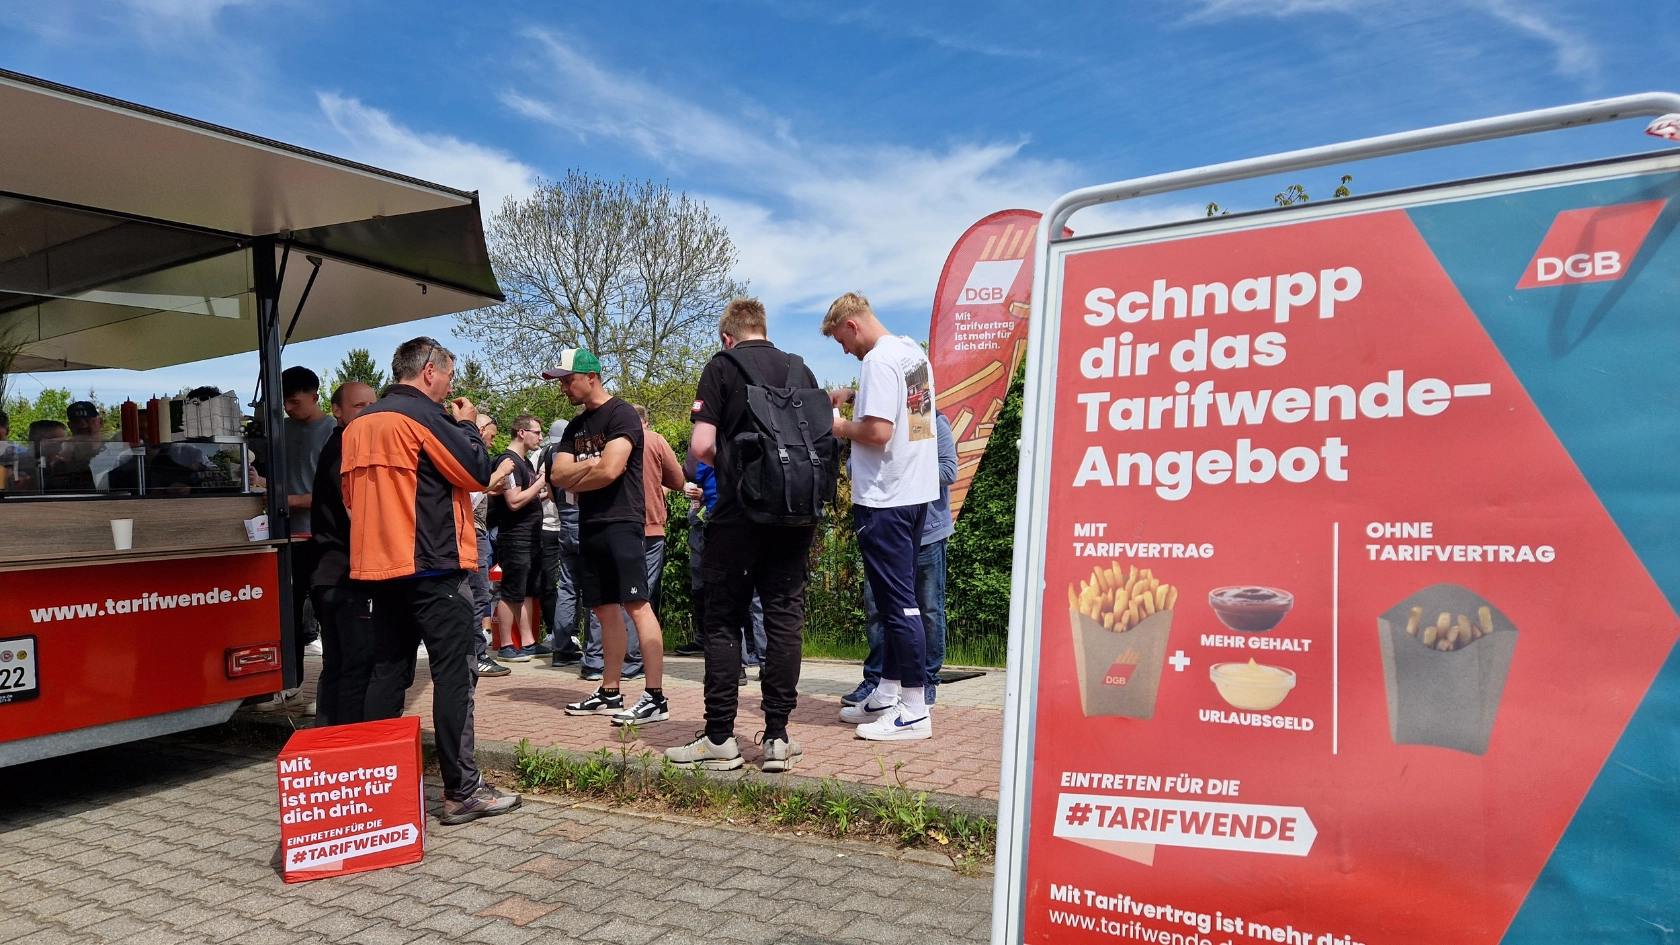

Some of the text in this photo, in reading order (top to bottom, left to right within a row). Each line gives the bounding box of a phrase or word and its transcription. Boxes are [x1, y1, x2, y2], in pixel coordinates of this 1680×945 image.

[1537, 251, 1621, 281] DGB
[965, 287, 1003, 301] DGB
[1084, 266, 1362, 327] Schnapp
[955, 312, 971, 320] Mit
[955, 321, 1014, 331] Tarifvertrag
[954, 330, 1012, 341] ist mehr für
[954, 341, 1000, 351] dich drin.
[1080, 328, 1287, 379] dir das
[1077, 369, 1491, 432] Tarifwende-
[1072, 437, 1348, 501] Angebot
[1074, 523, 1107, 537] MIT
[1366, 522, 1433, 538] OHNE
[1073, 542, 1214, 558] TARIFVERTRAG
[1366, 544, 1556, 563] TARIFVERTRAG
[30, 584, 263, 623] www.tarifwende.de
[1200, 634, 1312, 652] MEHR GEHALT
[0, 667, 26, 690] 22
[1105, 675, 1126, 685] DGB
[1199, 709, 1314, 731] URLAUBSGELD
[280, 757, 311, 774] Mit
[280, 764, 398, 790] Tarifvertrag
[281, 780, 392, 807] ist mehr für
[1060, 772, 1240, 796] EINTRETEN FÜR DIE
[283, 800, 373, 824] dich drin.
[1065, 802, 1297, 842] #TARIFWENDE
[287, 819, 383, 846] EINTRETEN FÜR DIE
[291, 828, 410, 864] #TARIFWENDE
[1050, 883, 1081, 905] Mit
[1084, 889, 1211, 934] Tarifvertrag
[1216, 911, 1244, 936] ist
[1248, 922, 1313, 945] mehr
